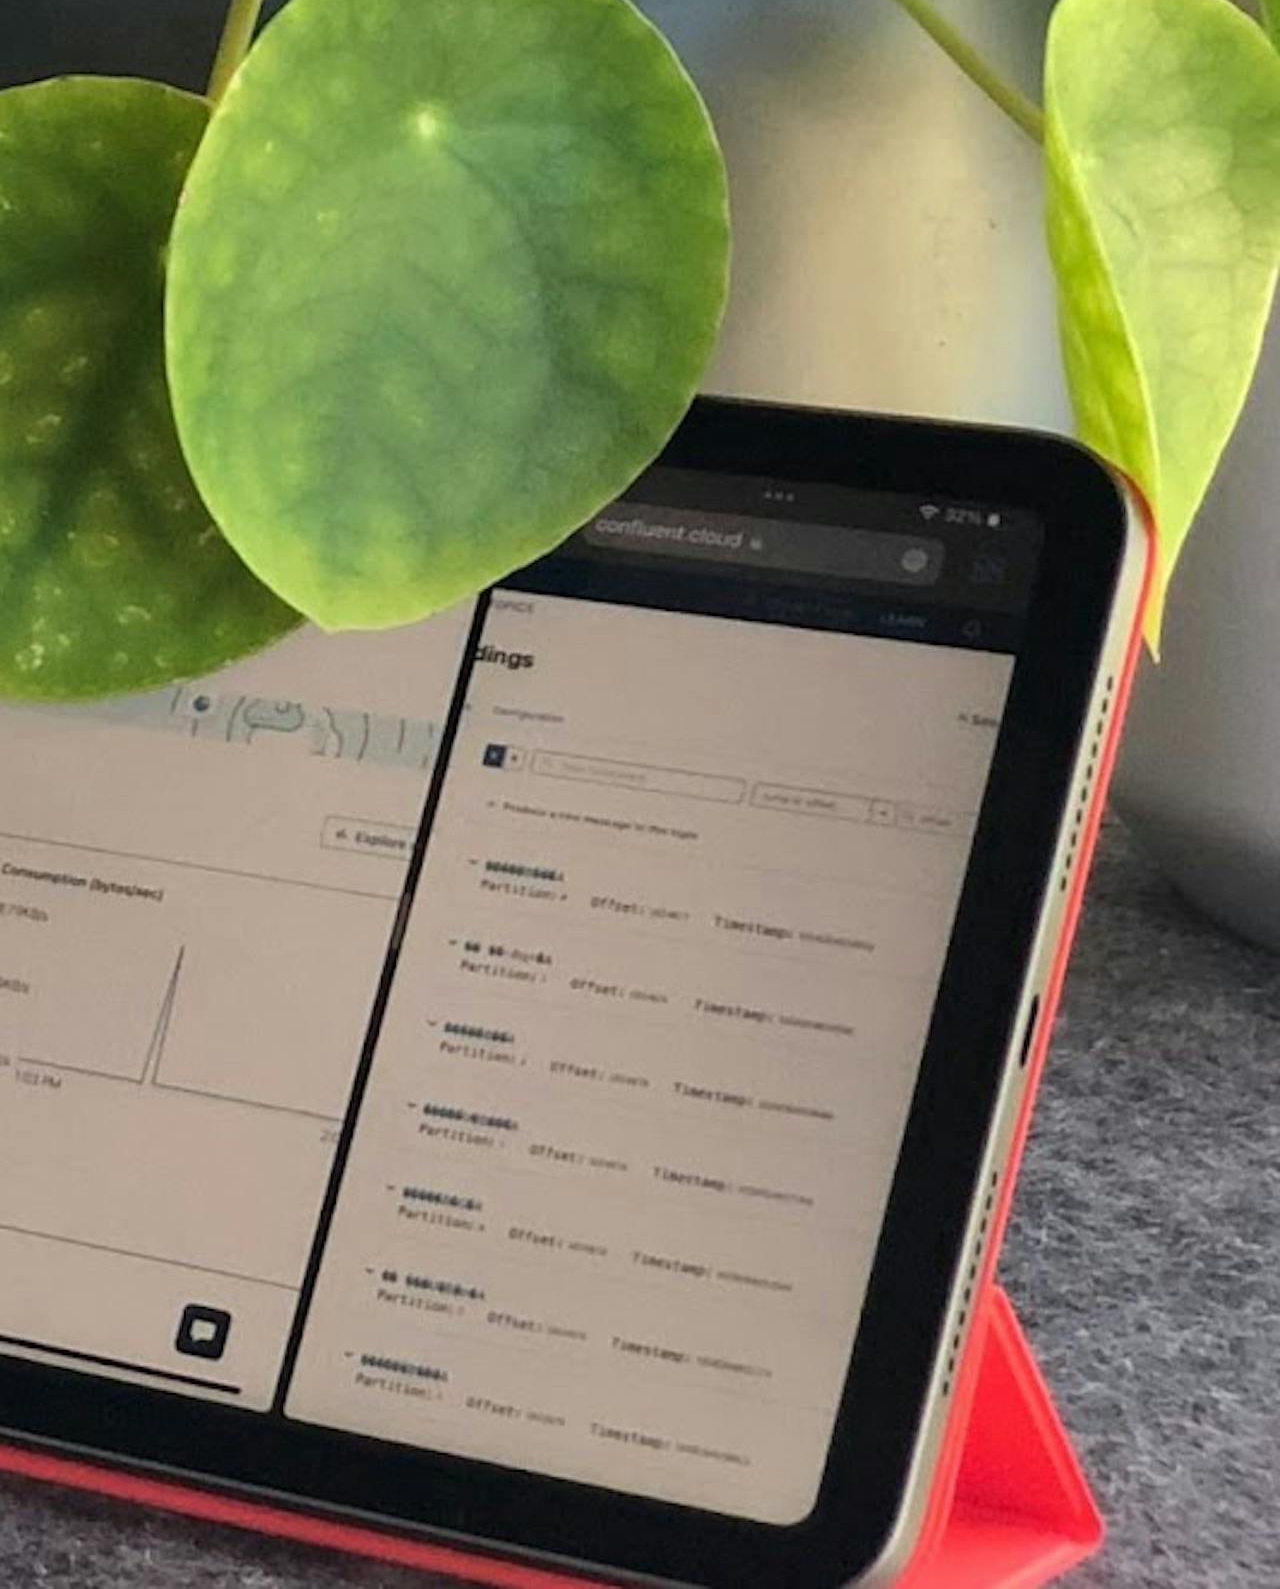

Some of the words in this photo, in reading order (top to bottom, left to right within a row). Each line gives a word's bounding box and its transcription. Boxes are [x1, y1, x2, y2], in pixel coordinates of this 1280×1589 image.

[593, 516, 744, 551] confluent.cloud
[355, 830, 407, 851] Explore
[1, 862, 88, 887] Consumption
[89, 877, 165, 903] (bytes/sec)
